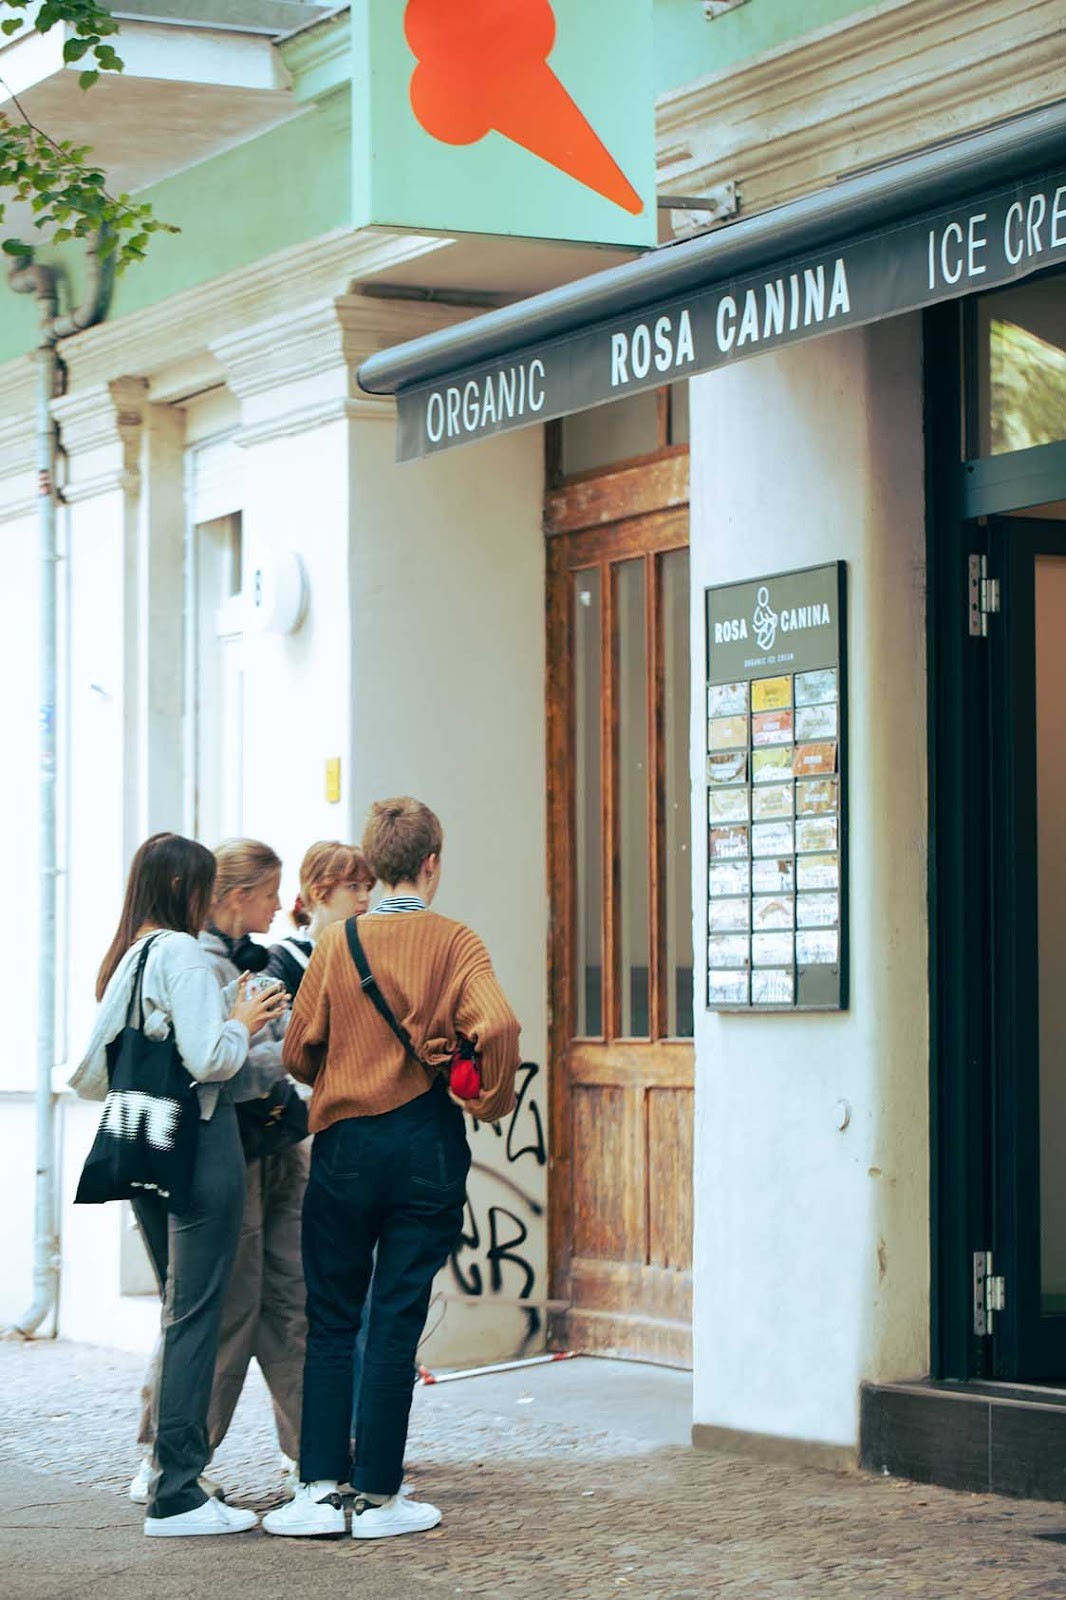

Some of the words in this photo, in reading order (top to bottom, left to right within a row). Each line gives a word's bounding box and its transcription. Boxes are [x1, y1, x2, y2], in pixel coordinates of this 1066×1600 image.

[426, 359, 545, 442] ORGANIC
[611, 309, 695, 387] ROSA
[716, 258, 850, 352] CANINA
[928, 213, 987, 290] ICE
[714, 618, 748, 643] ROSA
[780, 603, 830, 632] CANINA
